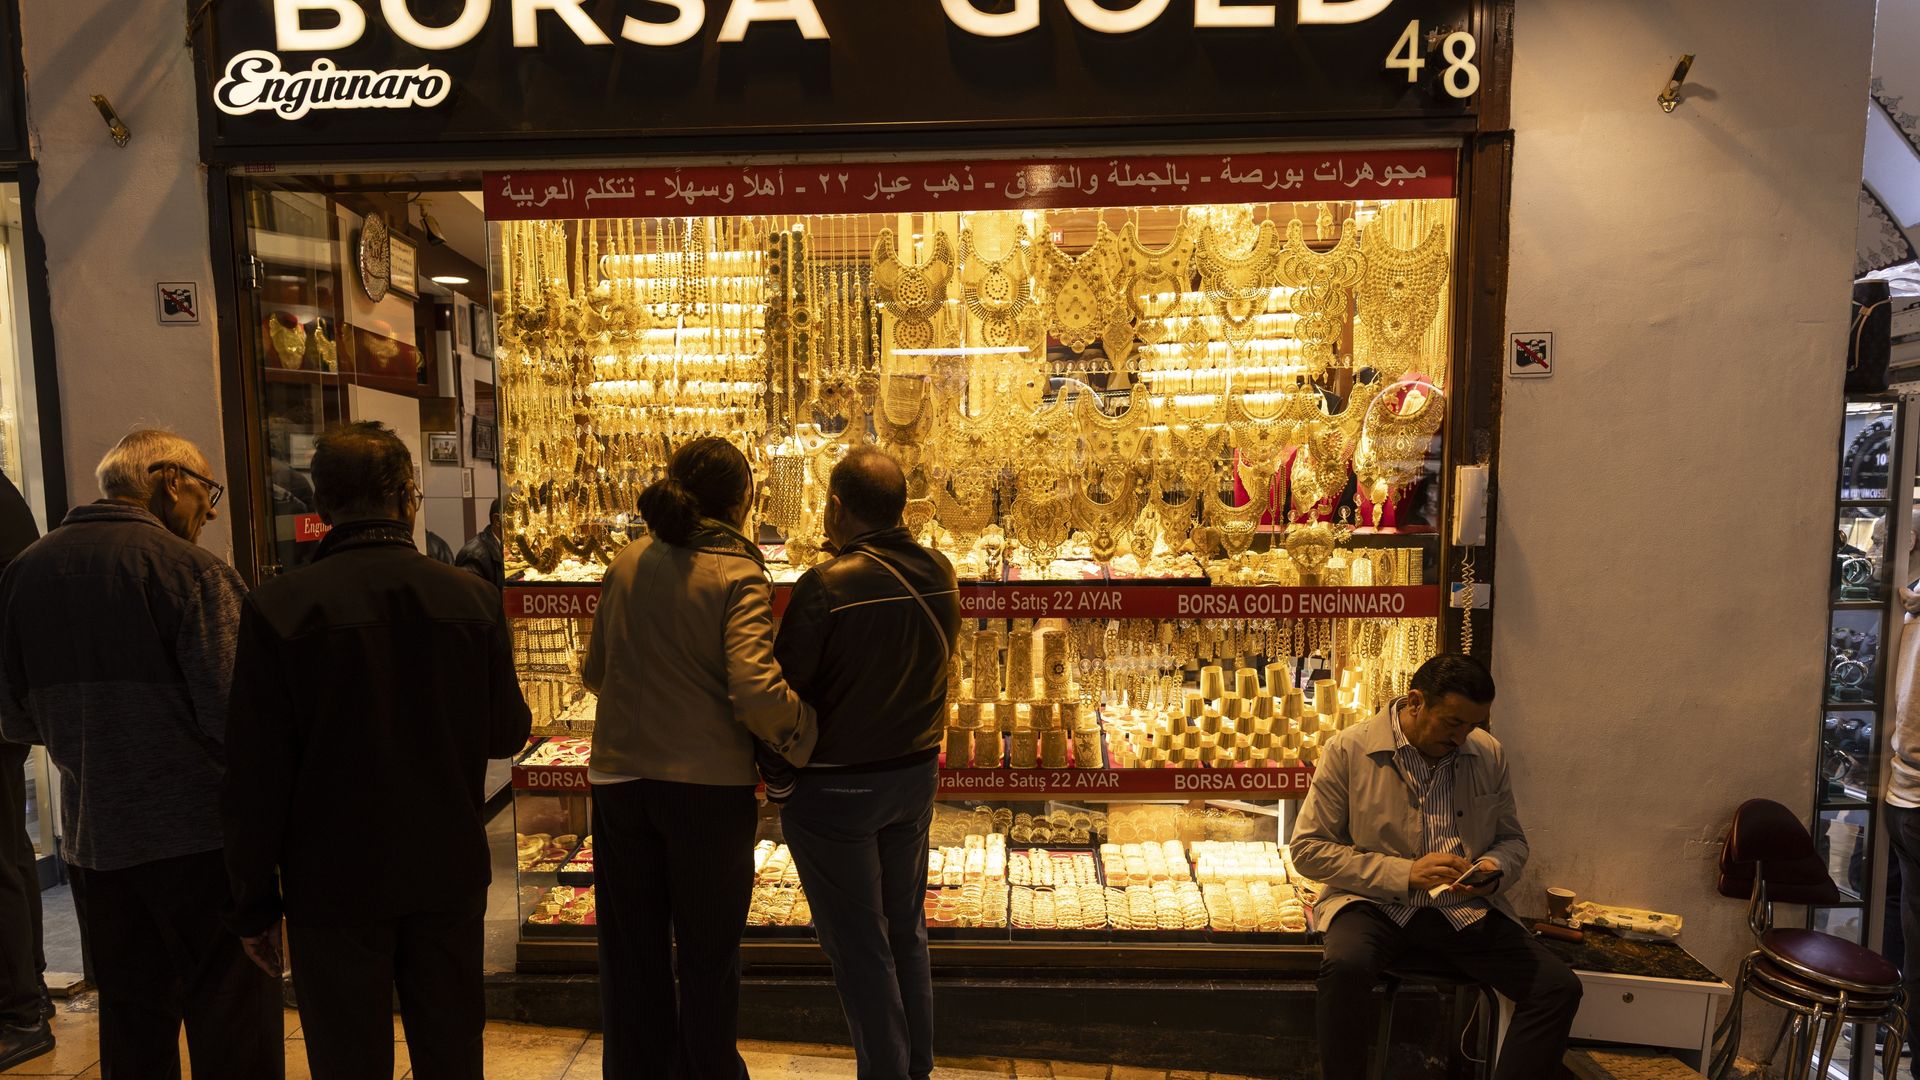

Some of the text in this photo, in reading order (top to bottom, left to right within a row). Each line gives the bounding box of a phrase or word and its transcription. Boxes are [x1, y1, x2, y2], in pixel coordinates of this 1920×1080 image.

[217, 57, 444, 114] Enginnaro
[863, 171, 912, 201] عيار
[923, 165, 975, 199] ذهب
[1004, 165, 1099, 199] والمرق
[1107, 158, 1190, 193] بالجملة
[1220, 157, 1304, 190] بورصة
[1313, 158, 1427, 188] مجوهرات
[501, 174, 575, 208] العربية
[584, 175, 636, 210] نتكلم
[522, 594, 582, 614] BORSA
[1010, 590, 1049, 616] Satış
[1053, 591, 1074, 610] 22
[1077, 591, 1122, 610] AYAR
[1178, 588, 1405, 614] BORSA GOLD ENGİNNARO
[527, 771, 586, 787] BORSA
[940, 772, 1120, 792] rakende Satış 22 AYAR
[1174, 773, 1236, 790] BORSA
[1240, 773, 1289, 789] GOLD
